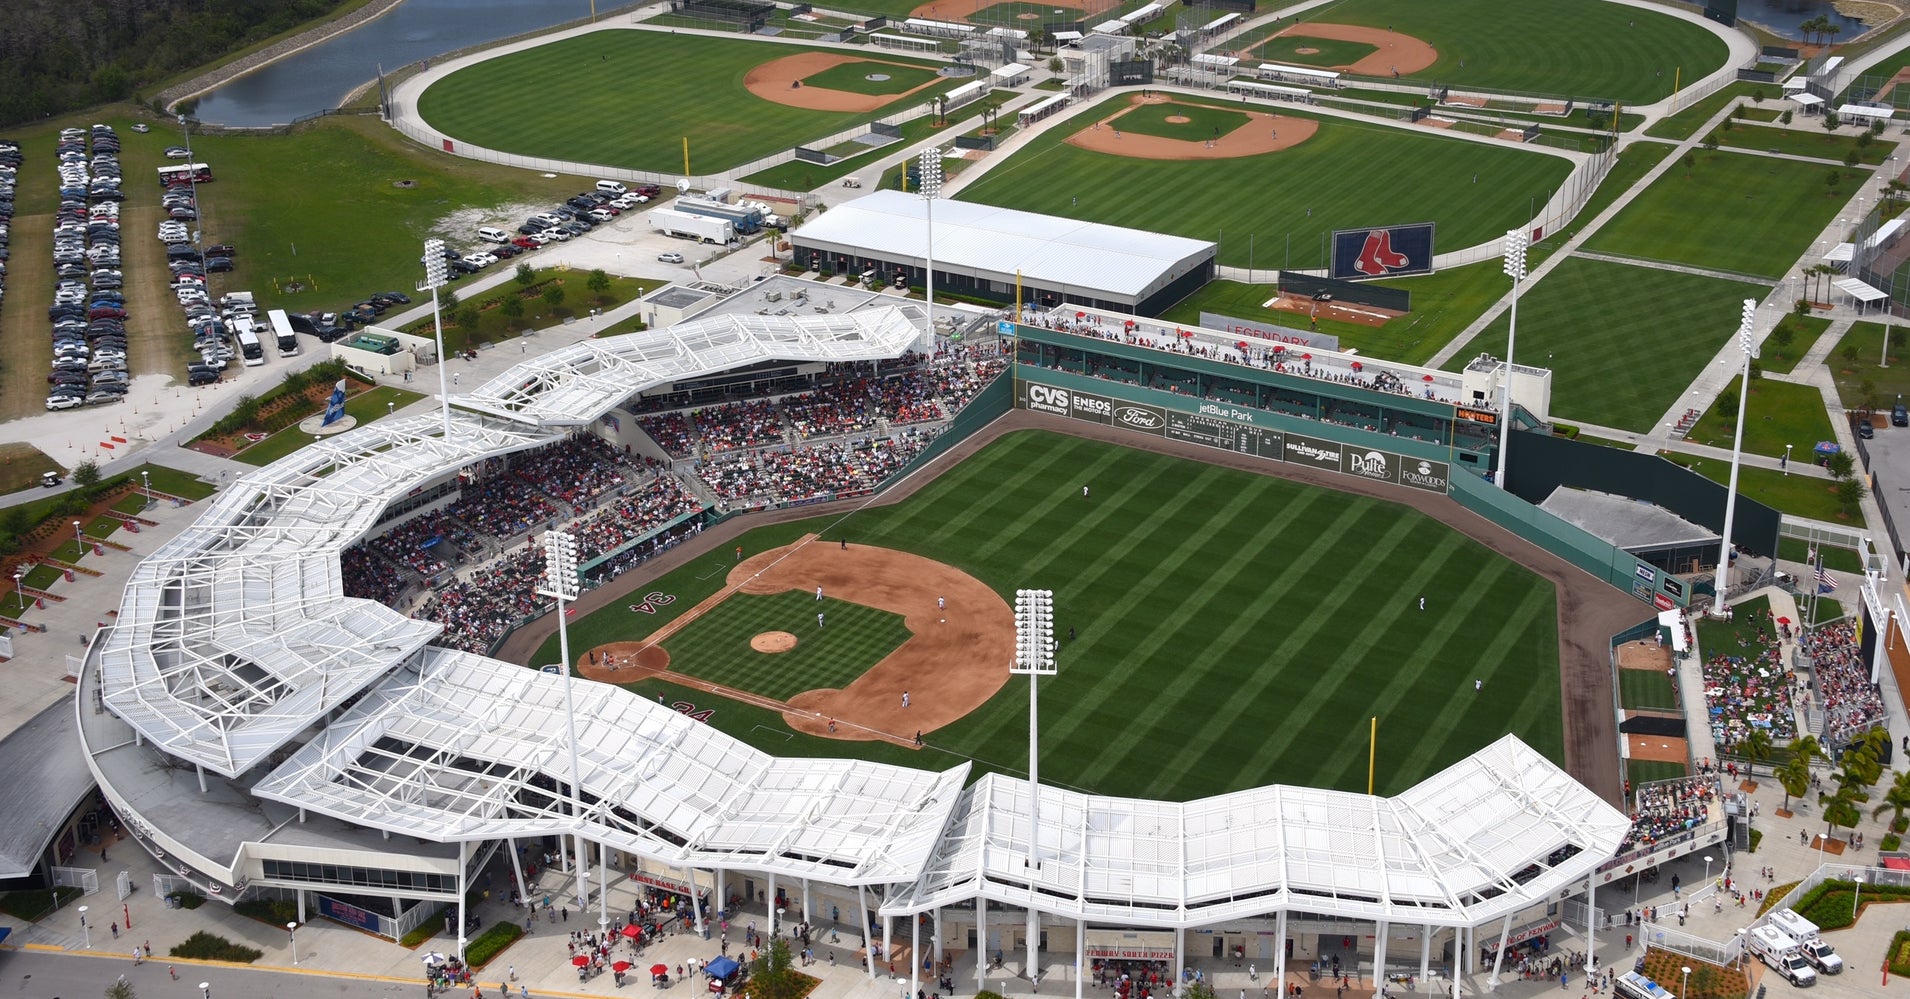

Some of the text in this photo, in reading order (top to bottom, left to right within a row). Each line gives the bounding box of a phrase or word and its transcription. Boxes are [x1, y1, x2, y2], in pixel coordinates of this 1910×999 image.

[1226, 324, 1309, 346] LEGENDARY
[1030, 385, 1069, 407] CVS
[1073, 396, 1111, 412] ENEOS
[1030, 401, 1068, 415] pharmacy
[1123, 408, 1156, 427] Ford
[1199, 402, 1253, 422] jetBlue Park
[1325, 450, 1340, 459] TIRE
[1350, 453, 1386, 474] Pulte
[1402, 470, 1446, 487] FOXWOODS
[629, 592, 676, 614] 34
